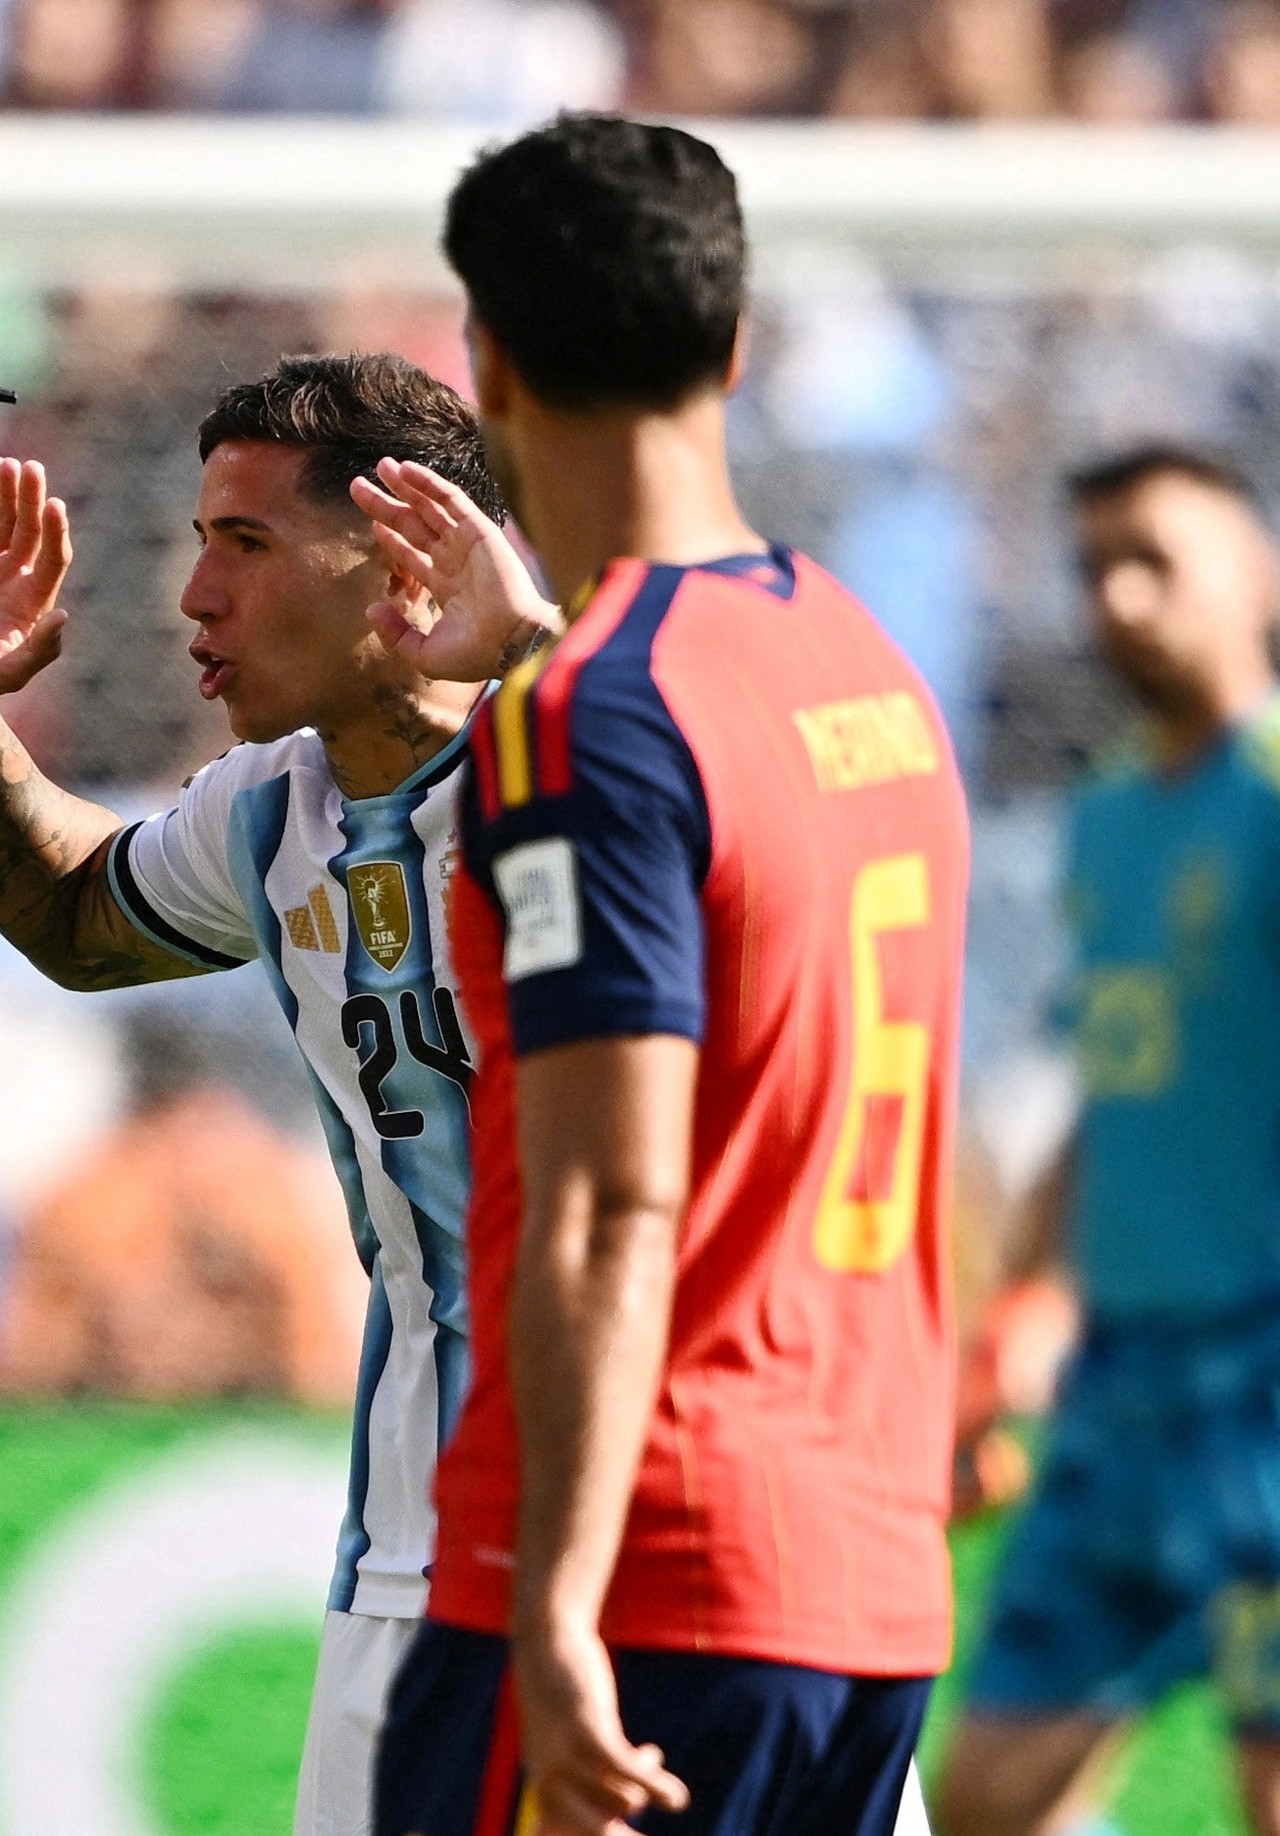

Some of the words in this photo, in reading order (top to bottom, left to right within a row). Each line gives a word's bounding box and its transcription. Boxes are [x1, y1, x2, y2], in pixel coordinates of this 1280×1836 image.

[370, 930, 397, 946] FIFA
[340, 986, 478, 1140] 24
[813, 852, 930, 1273] 6
